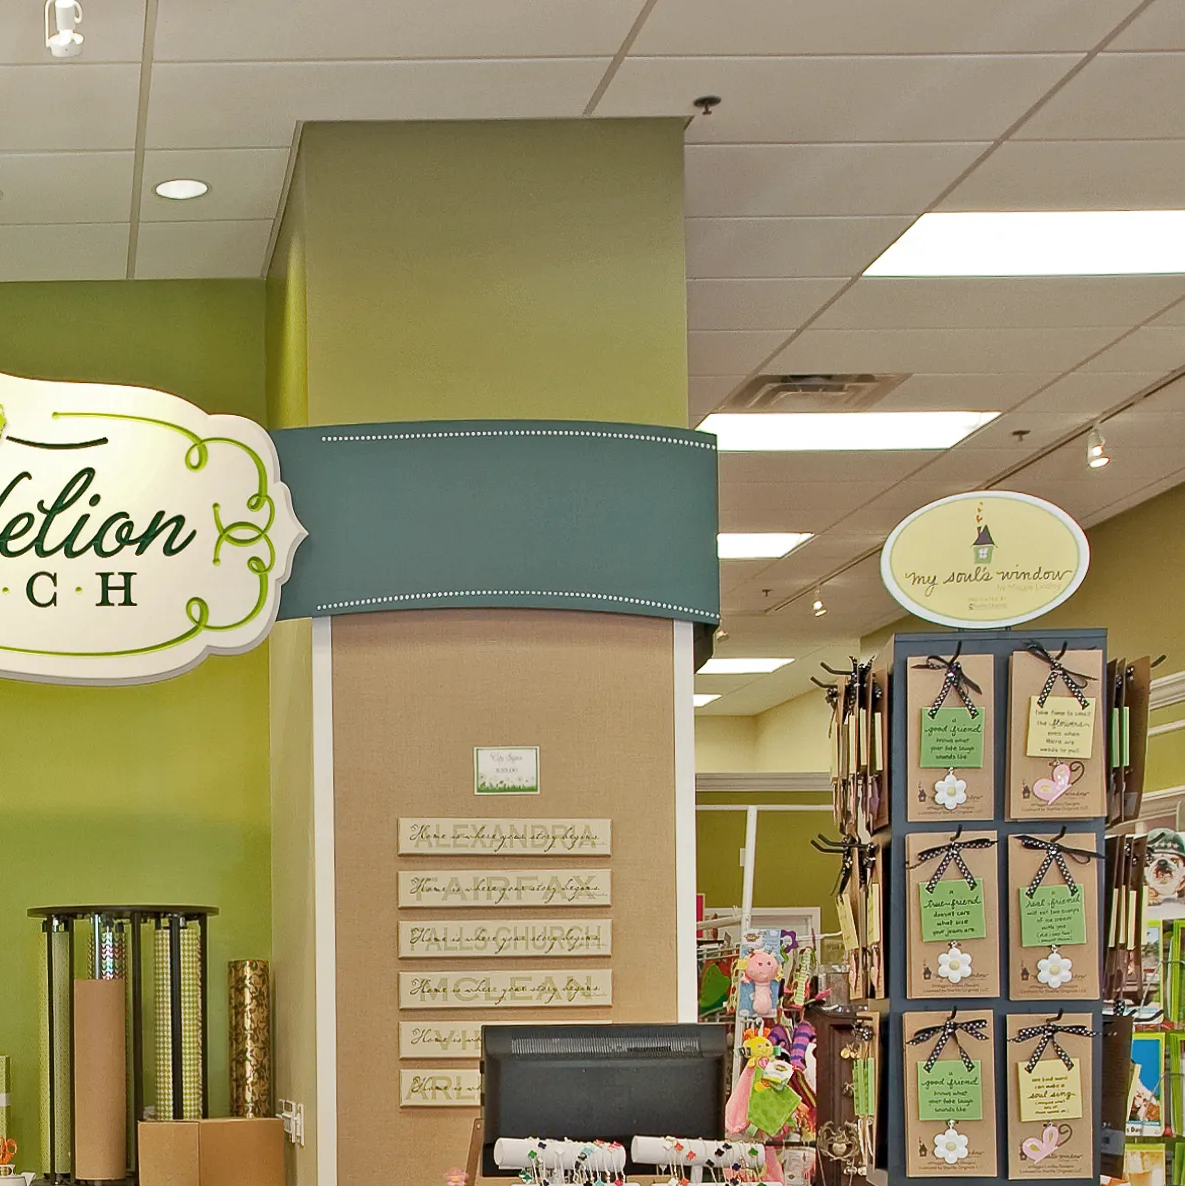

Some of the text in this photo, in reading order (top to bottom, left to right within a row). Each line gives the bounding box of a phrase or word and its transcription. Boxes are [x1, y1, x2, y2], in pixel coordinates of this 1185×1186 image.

[905, 564, 1073, 598] my soul's window
[950, 724, 981, 737] friend
[415, 824, 597, 849] ALEXANDRIA
[415, 876, 597, 901] FAIRFAX
[410, 925, 601, 951] FALLS CHURCH
[419, 975, 593, 1002] MCLEAN
[405, 1075, 480, 1101] ARL
[921, 1076, 979, 1090] good friend
